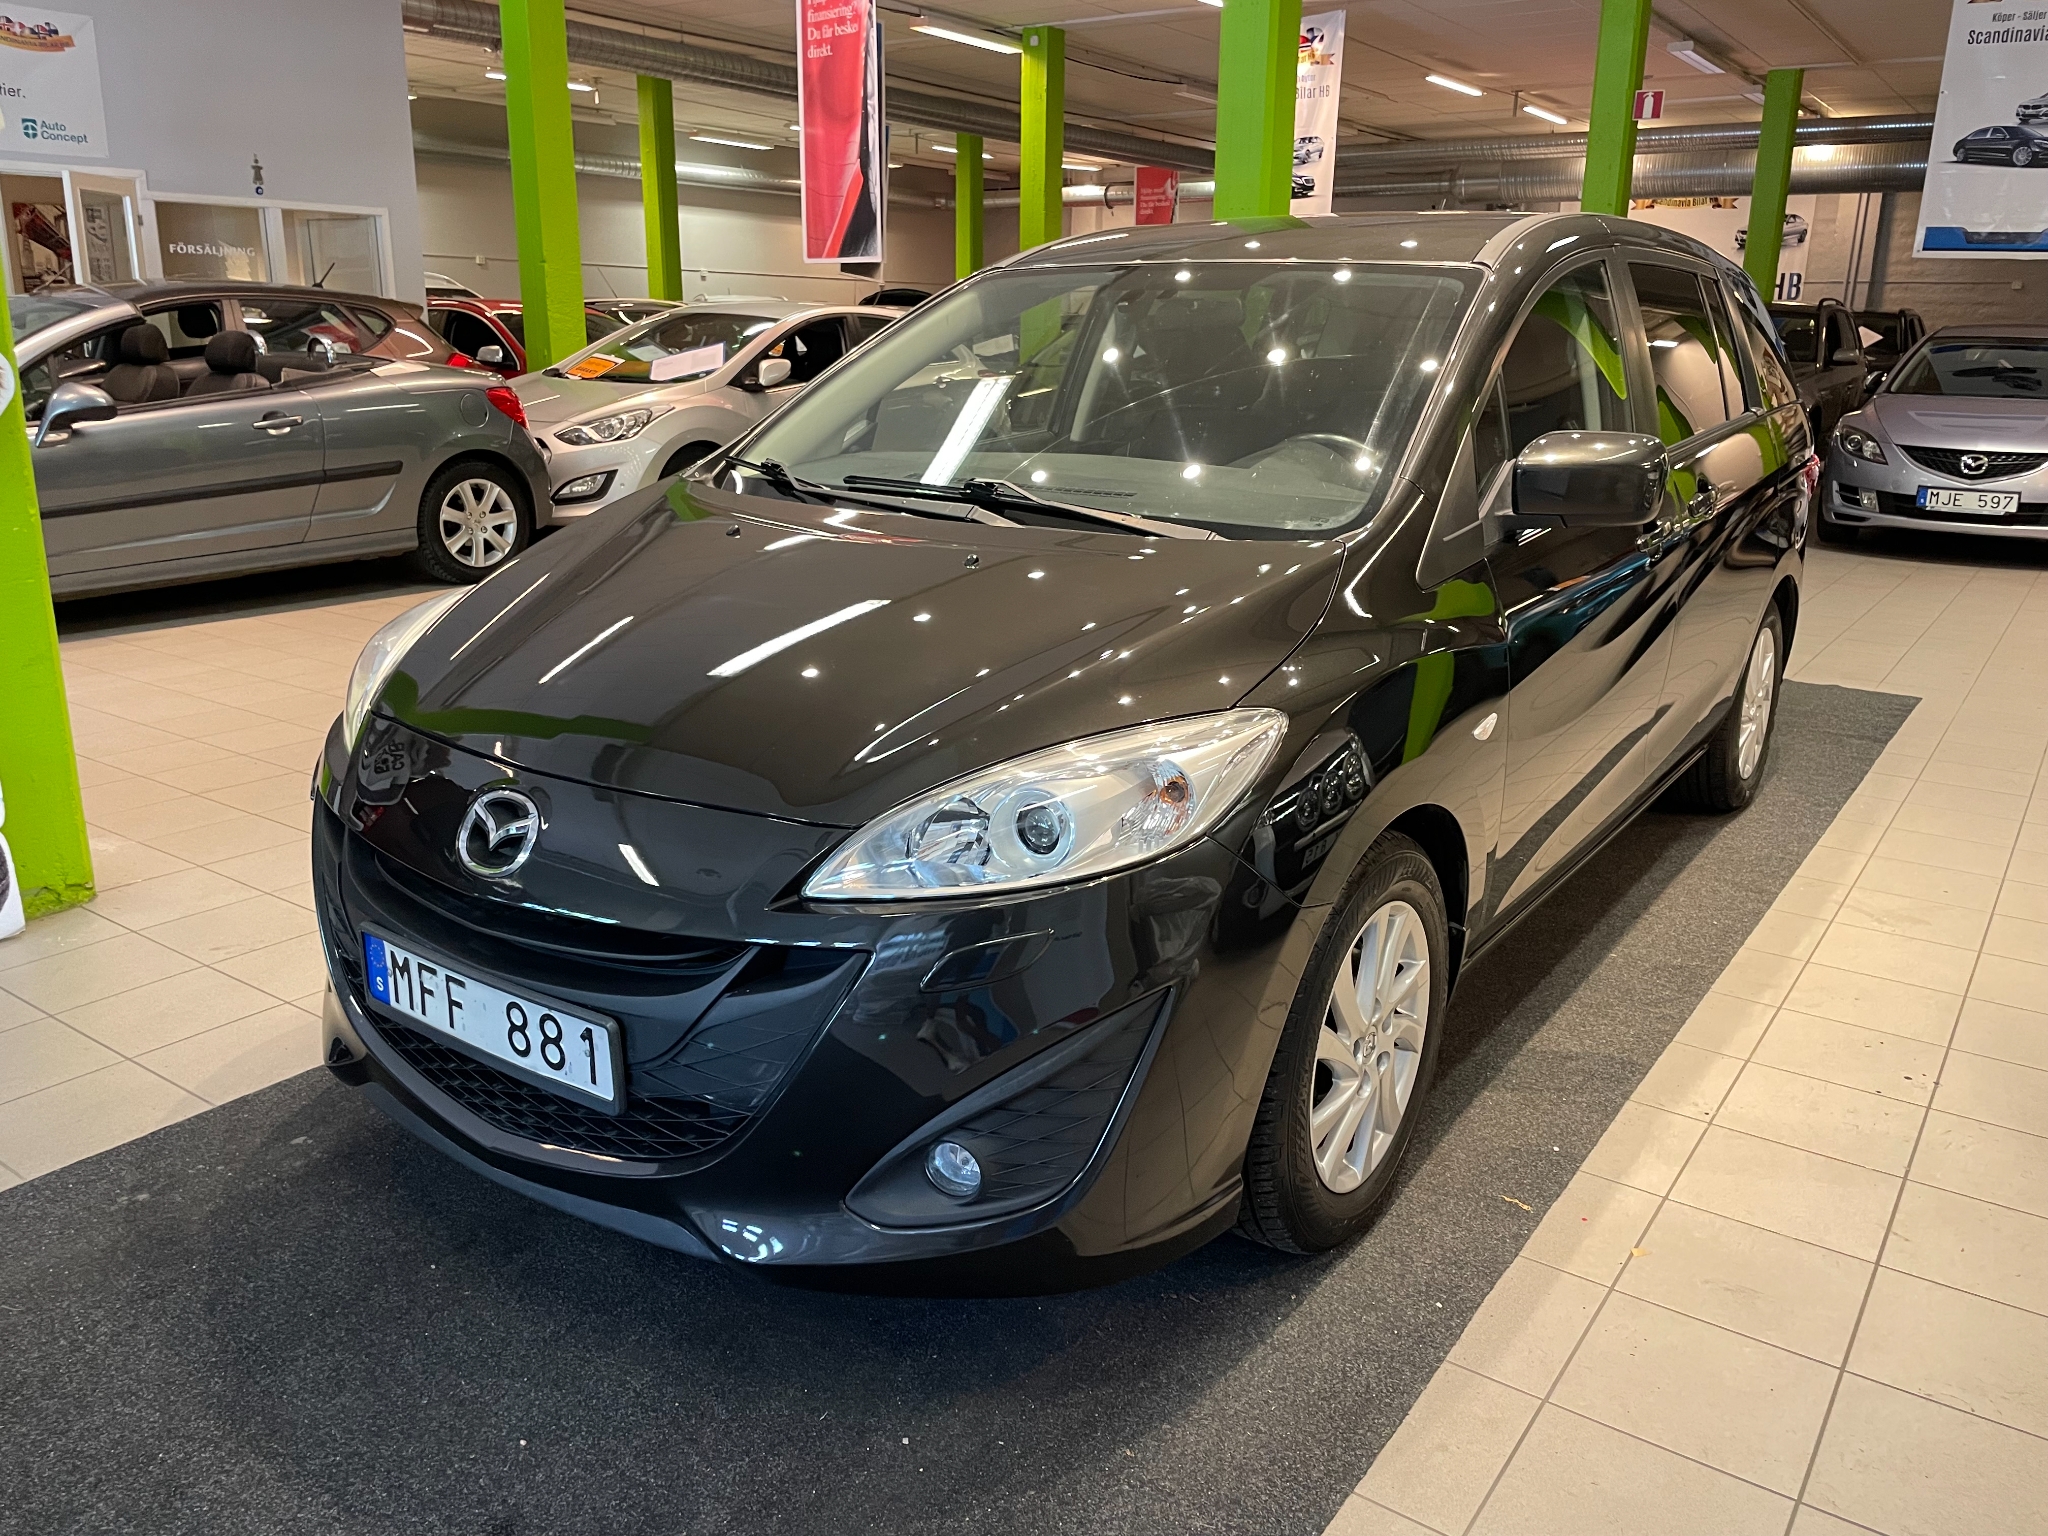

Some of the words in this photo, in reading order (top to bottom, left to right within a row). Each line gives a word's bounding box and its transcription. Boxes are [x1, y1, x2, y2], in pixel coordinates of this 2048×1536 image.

[1992, 12, 2016, 23] Köper
[2023, 10, 2048, 21] Säljer
[807, 28, 821, 41] Du
[41, 120, 67, 132] Auto
[41, 130, 89, 145] Concept
[168, 242, 256, 258] FÖRSÄLJNING
[1929, 491, 1964, 507] MJE
[1978, 494, 2015, 510] 597
[376, 976, 384, 992] S
[390, 949, 466, 1030] MFF
[505, 1001, 598, 1086] 881
